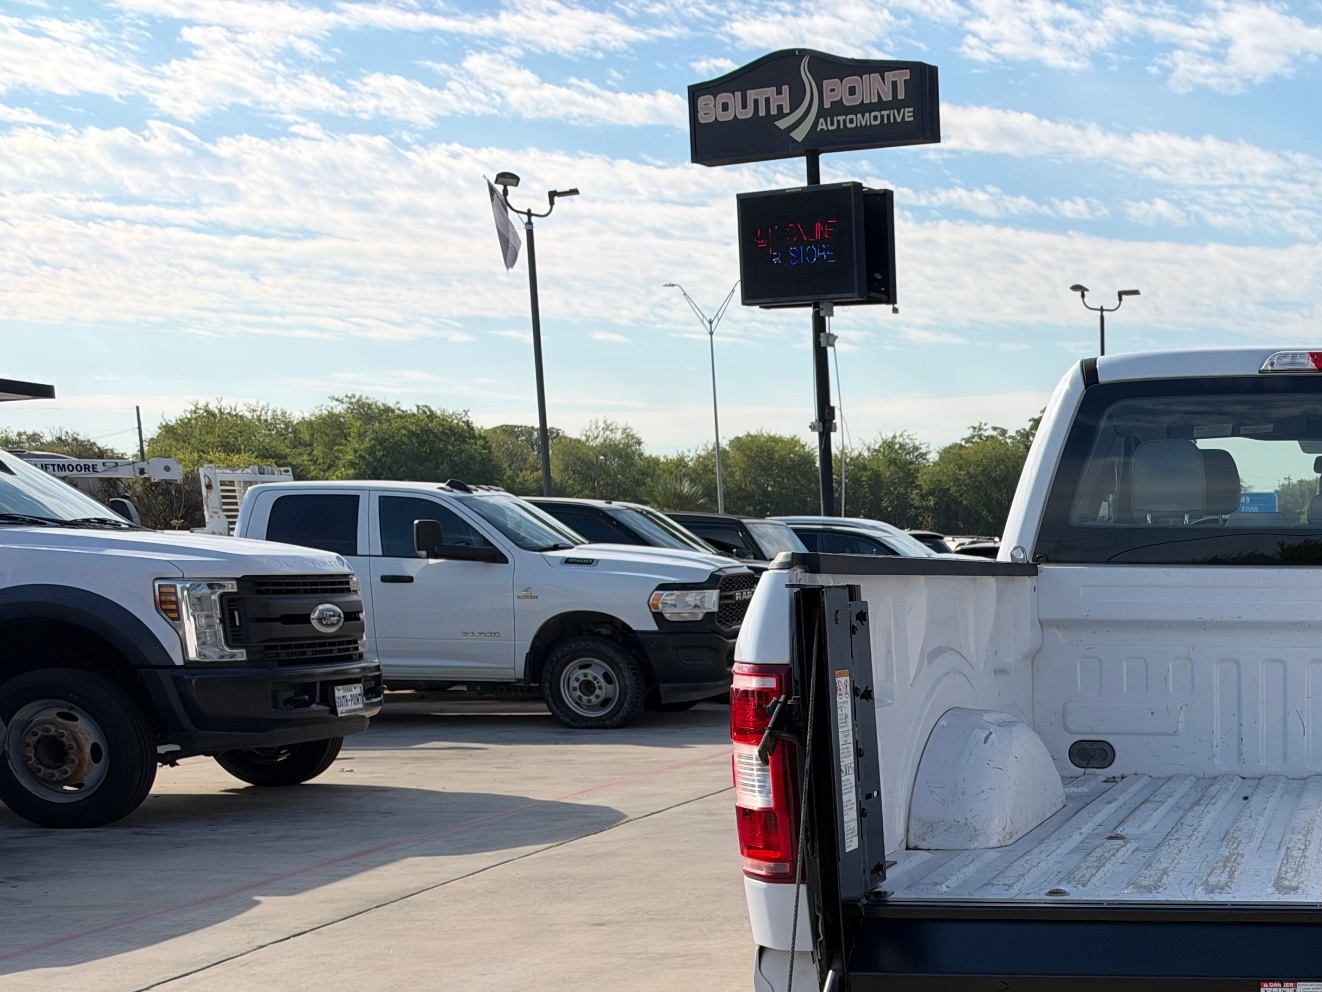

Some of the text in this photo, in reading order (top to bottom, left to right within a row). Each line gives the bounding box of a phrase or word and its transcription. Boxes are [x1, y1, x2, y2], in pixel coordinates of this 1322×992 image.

[697, 69, 911, 124] SOUTH POINT
[816, 107, 914, 132] AUTOMOTIVE
[33, 463, 99, 473] IFTMOORE
[321, 611, 340, 625] Ford
